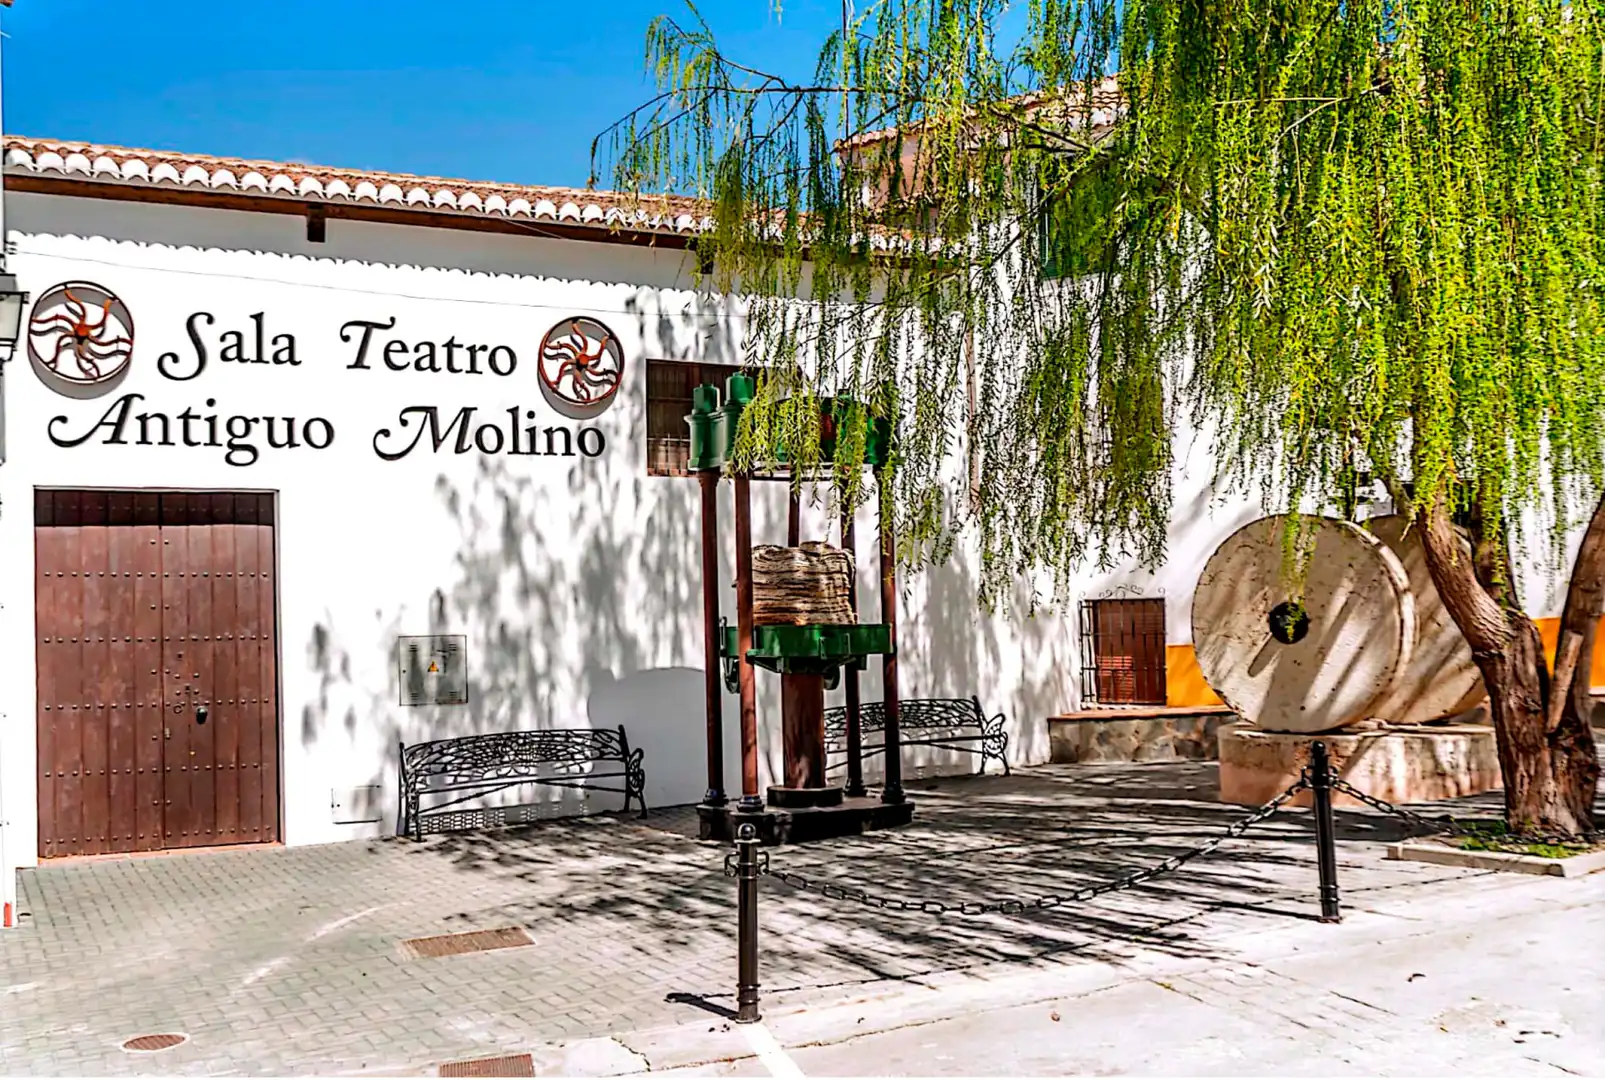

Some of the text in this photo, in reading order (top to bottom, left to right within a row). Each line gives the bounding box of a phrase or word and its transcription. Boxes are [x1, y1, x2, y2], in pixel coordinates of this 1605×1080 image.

[157, 311, 518, 381] Sala Teatro
[47, 393, 606, 467] Antiguo Molino
